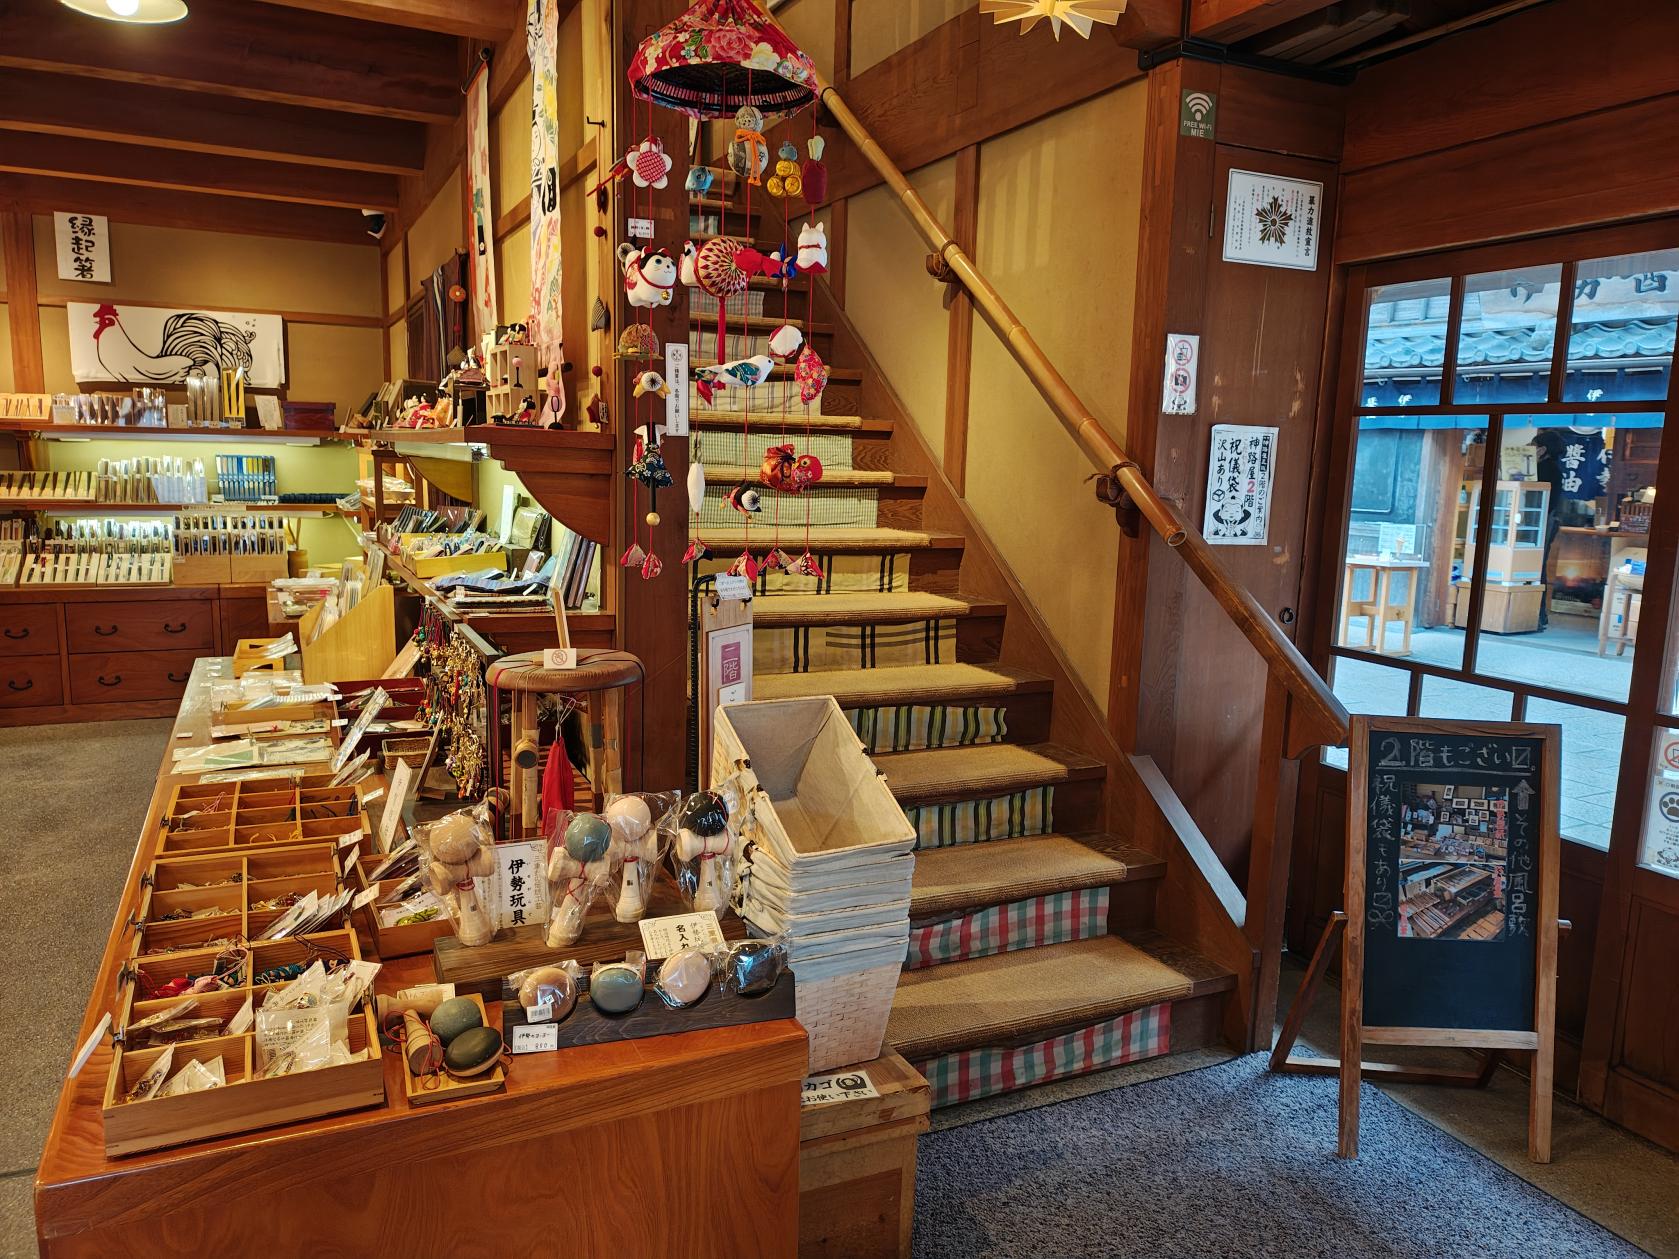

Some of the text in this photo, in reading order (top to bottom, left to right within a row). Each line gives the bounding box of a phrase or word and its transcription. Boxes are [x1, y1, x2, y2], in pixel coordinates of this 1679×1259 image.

[1183, 120, 1198, 128] FREE
[1190, 128, 1205, 137] MIE
[68, 216, 96, 281] 縁起箸
[1227, 438, 1242, 493] 祝儀袋
[1244, 437, 1260, 508] 神路屋2階
[508, 858, 527, 926] 伊勢玩具
[800, 1090, 873, 1102] お使い下さい
[804, 1080, 832, 1091] カゴ
